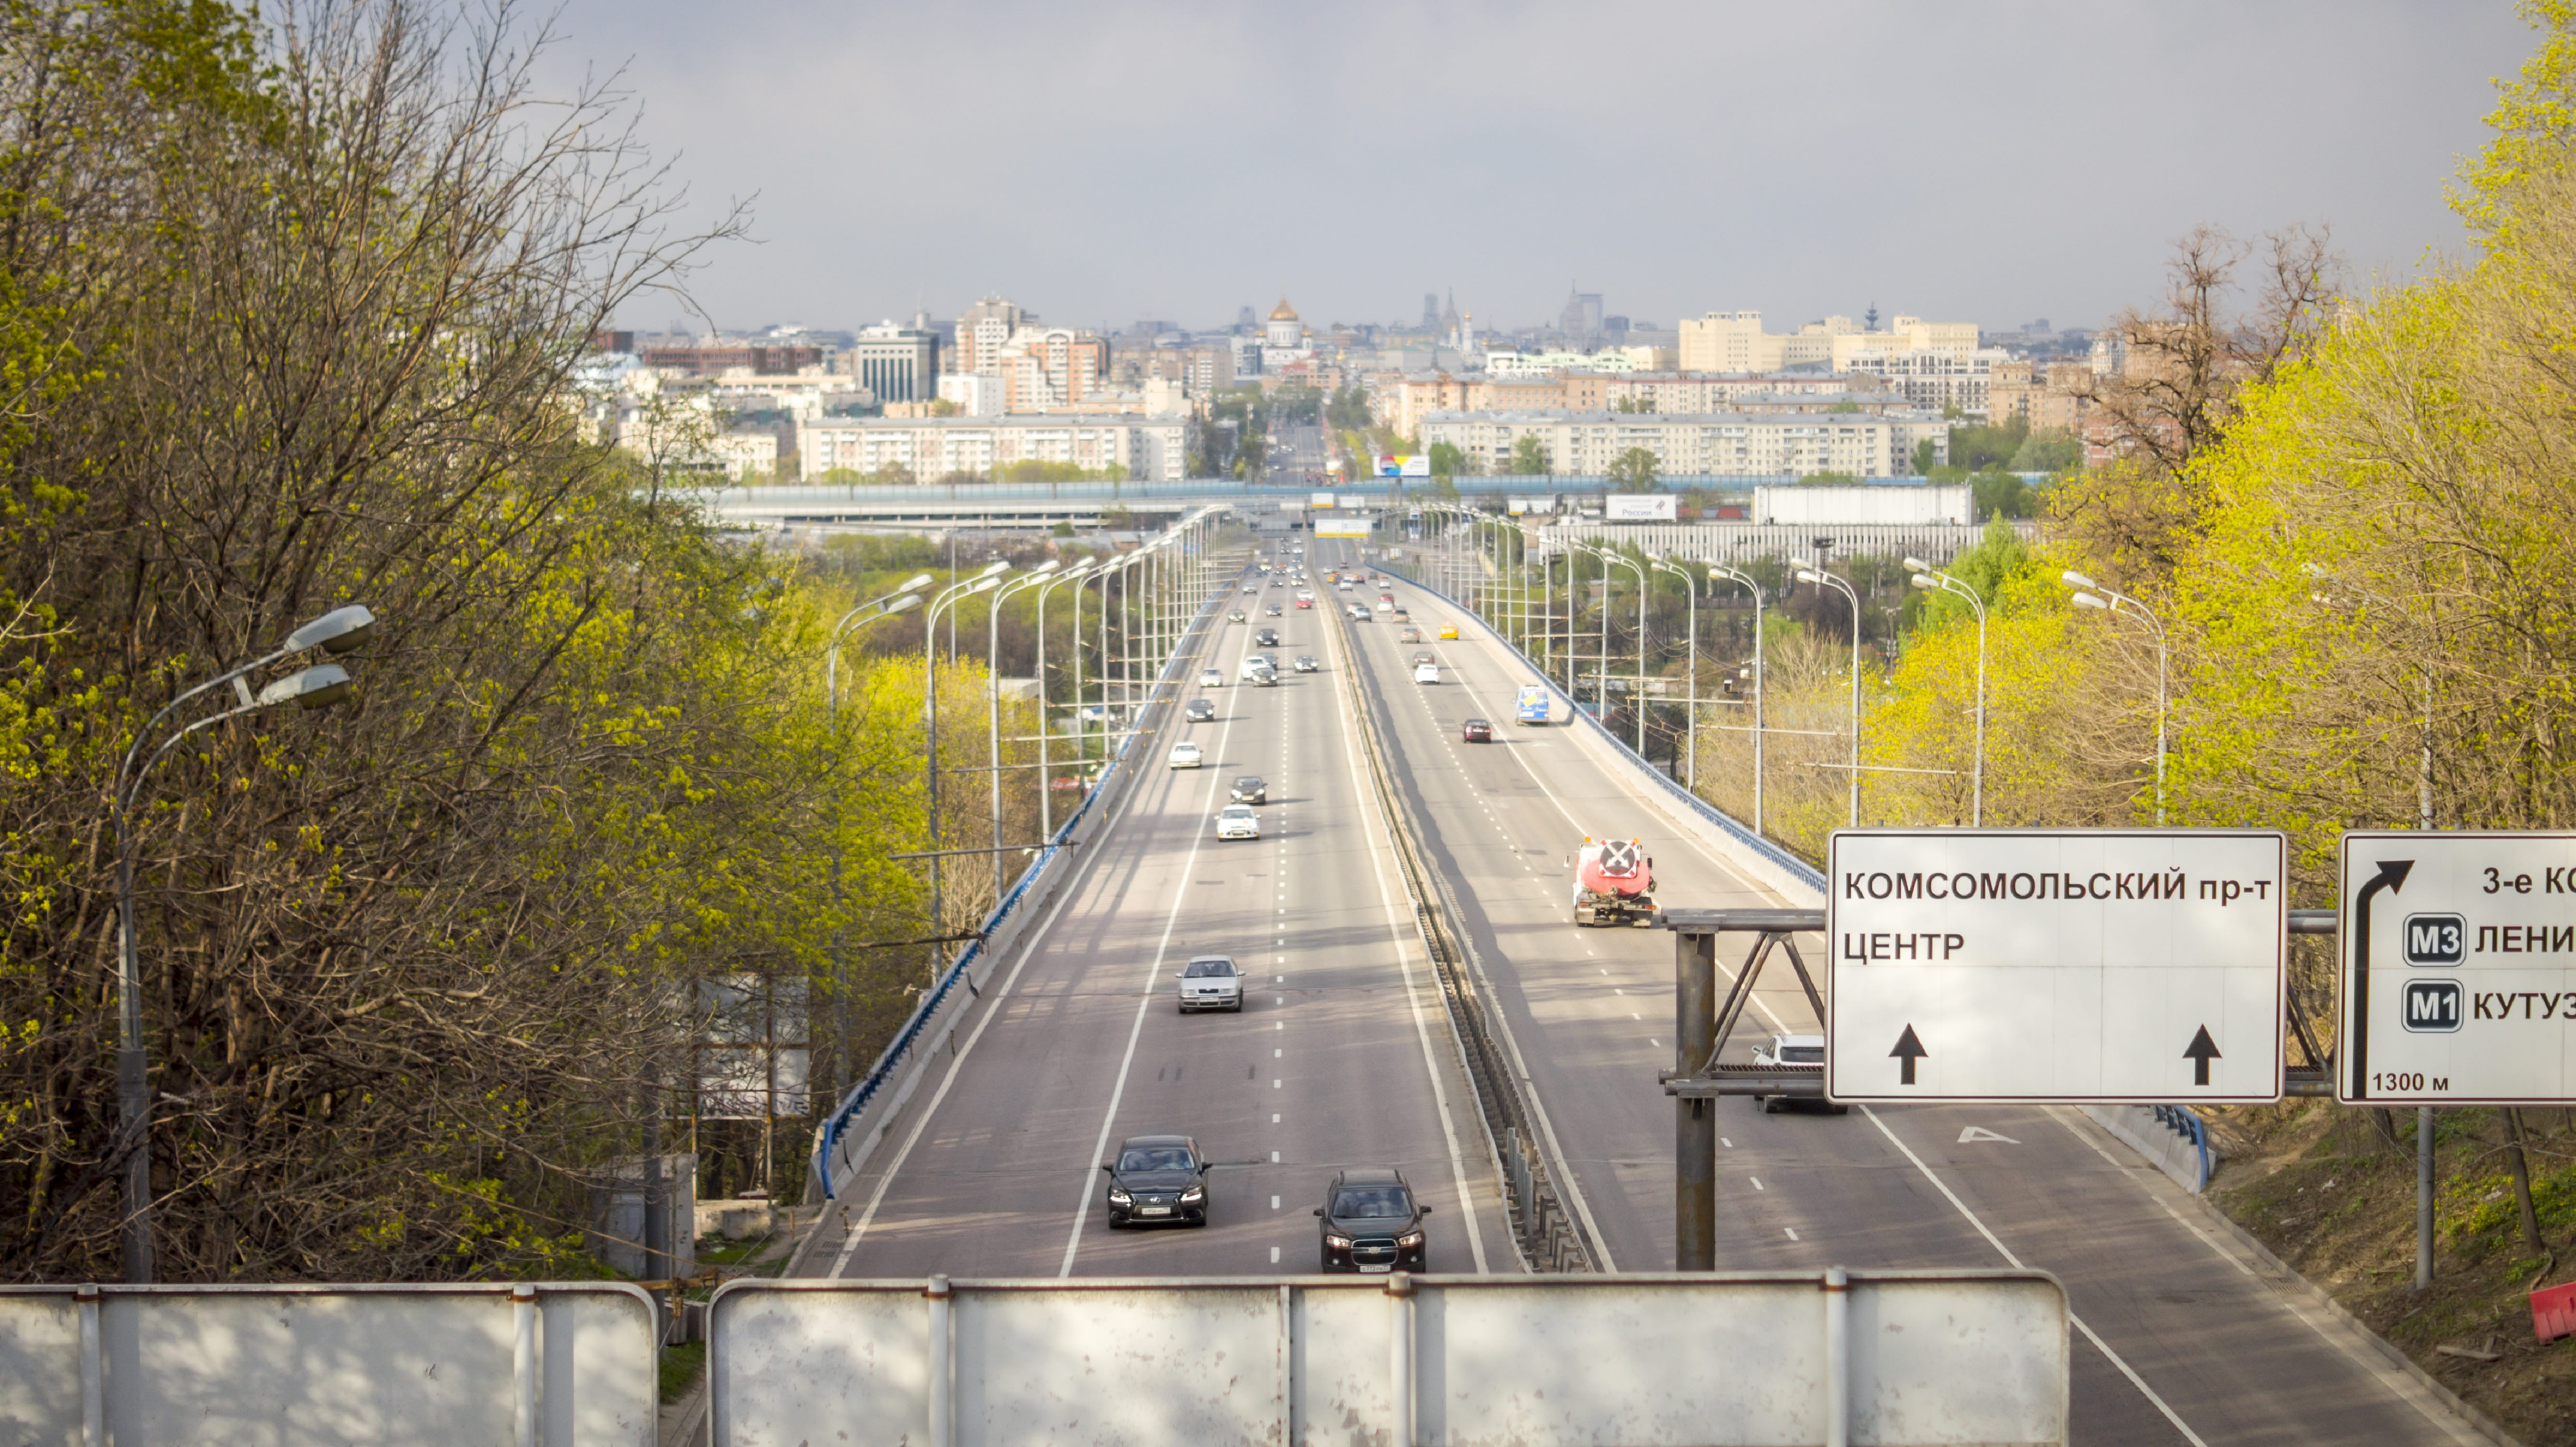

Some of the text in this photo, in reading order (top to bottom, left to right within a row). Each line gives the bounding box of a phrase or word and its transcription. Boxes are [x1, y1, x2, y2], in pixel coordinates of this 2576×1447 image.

[1846, 866, 2272, 906] КОМСОМОЛЬСКИЙ пр-т
[2482, 867, 2533, 894] 3-е
[1844, 933, 1965, 965] ЦЕНТР
[2412, 926, 2574, 954] М3 ЛЕНИ
[2412, 992, 2456, 1020] М1
[2372, 1073, 2449, 1091] 1300 м
